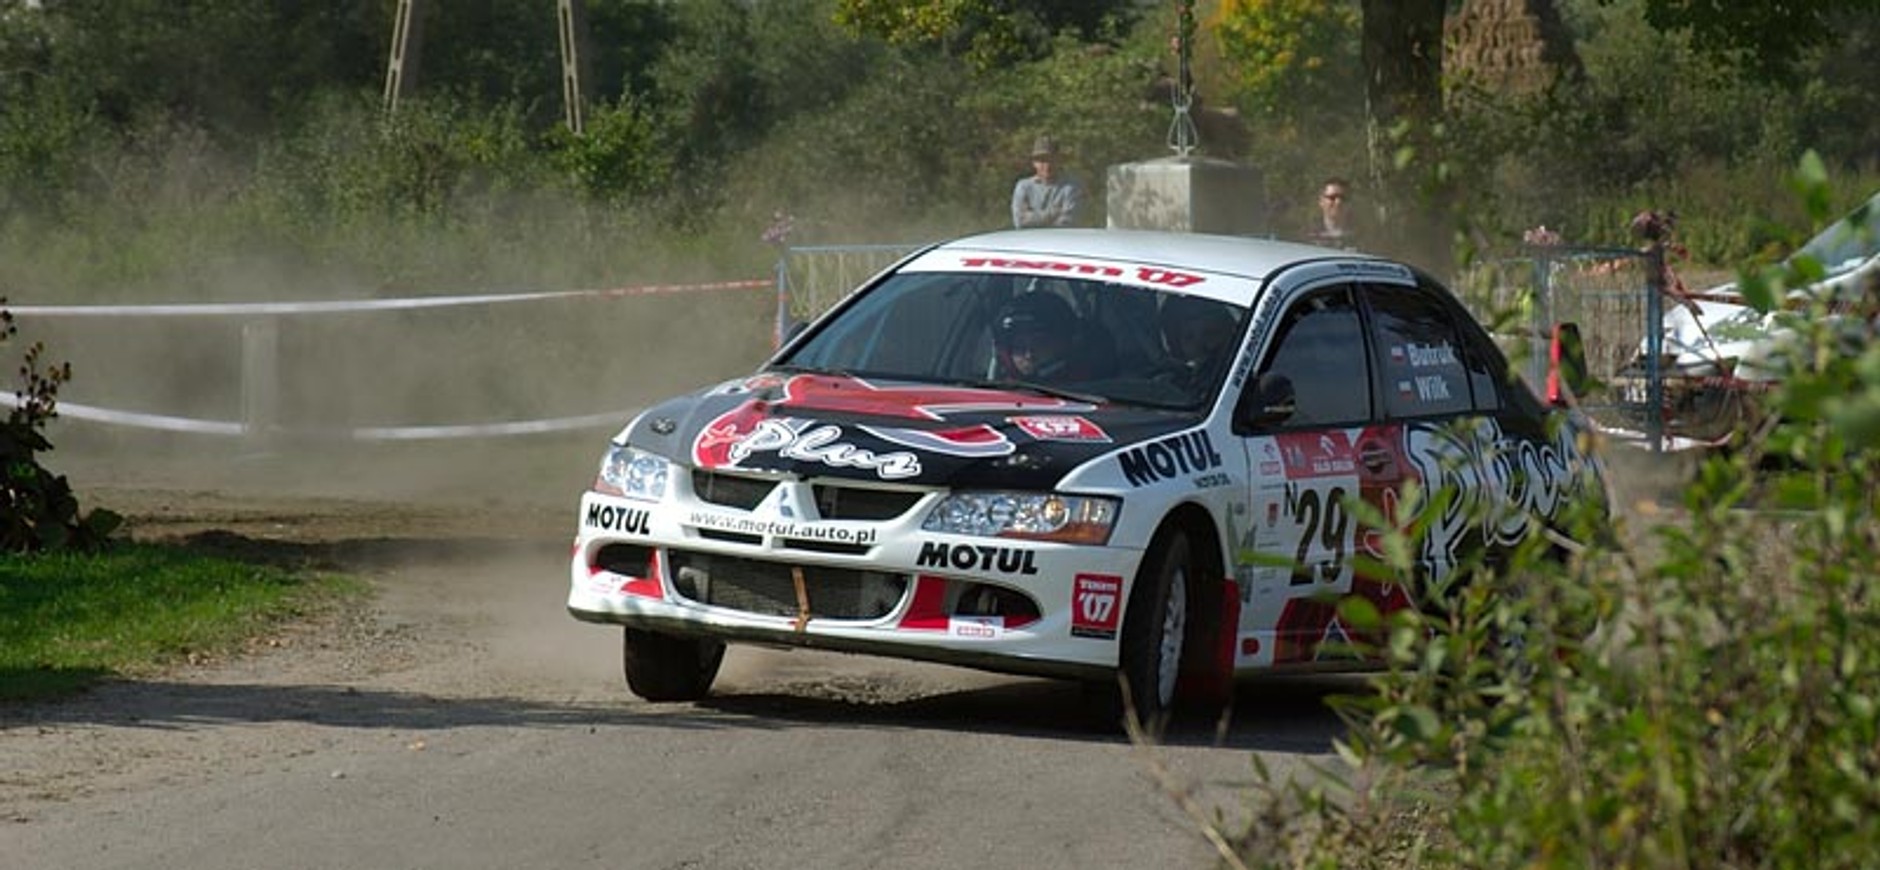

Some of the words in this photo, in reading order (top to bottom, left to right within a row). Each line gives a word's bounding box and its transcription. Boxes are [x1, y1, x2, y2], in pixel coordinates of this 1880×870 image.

[1117, 427, 1222, 488] MOTUL
[585, 503, 650, 536] MOTUL
[1290, 486, 1349, 586] 29
[917, 541, 1038, 575] MOTUL
